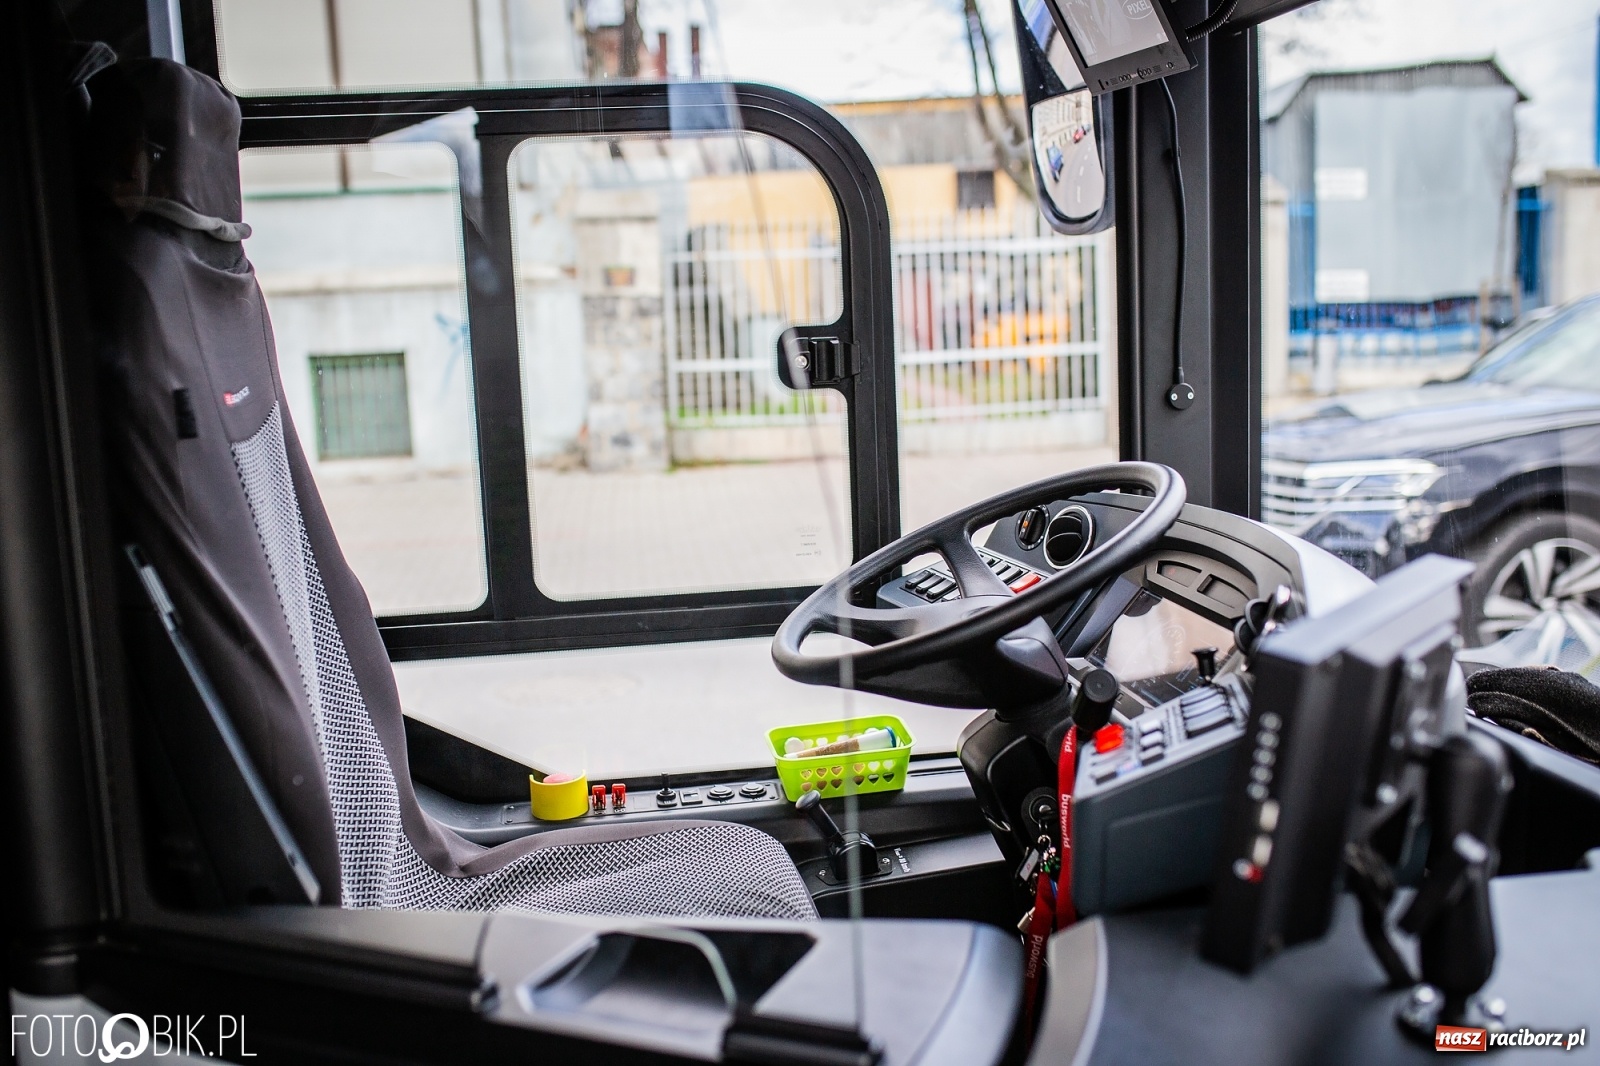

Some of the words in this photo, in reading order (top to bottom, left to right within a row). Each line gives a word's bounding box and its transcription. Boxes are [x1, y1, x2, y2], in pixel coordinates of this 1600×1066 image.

[1126, 0, 1151, 15] PIXEL
[1061, 793, 1072, 849] busworld
[1026, 934, 1044, 979] busworld
